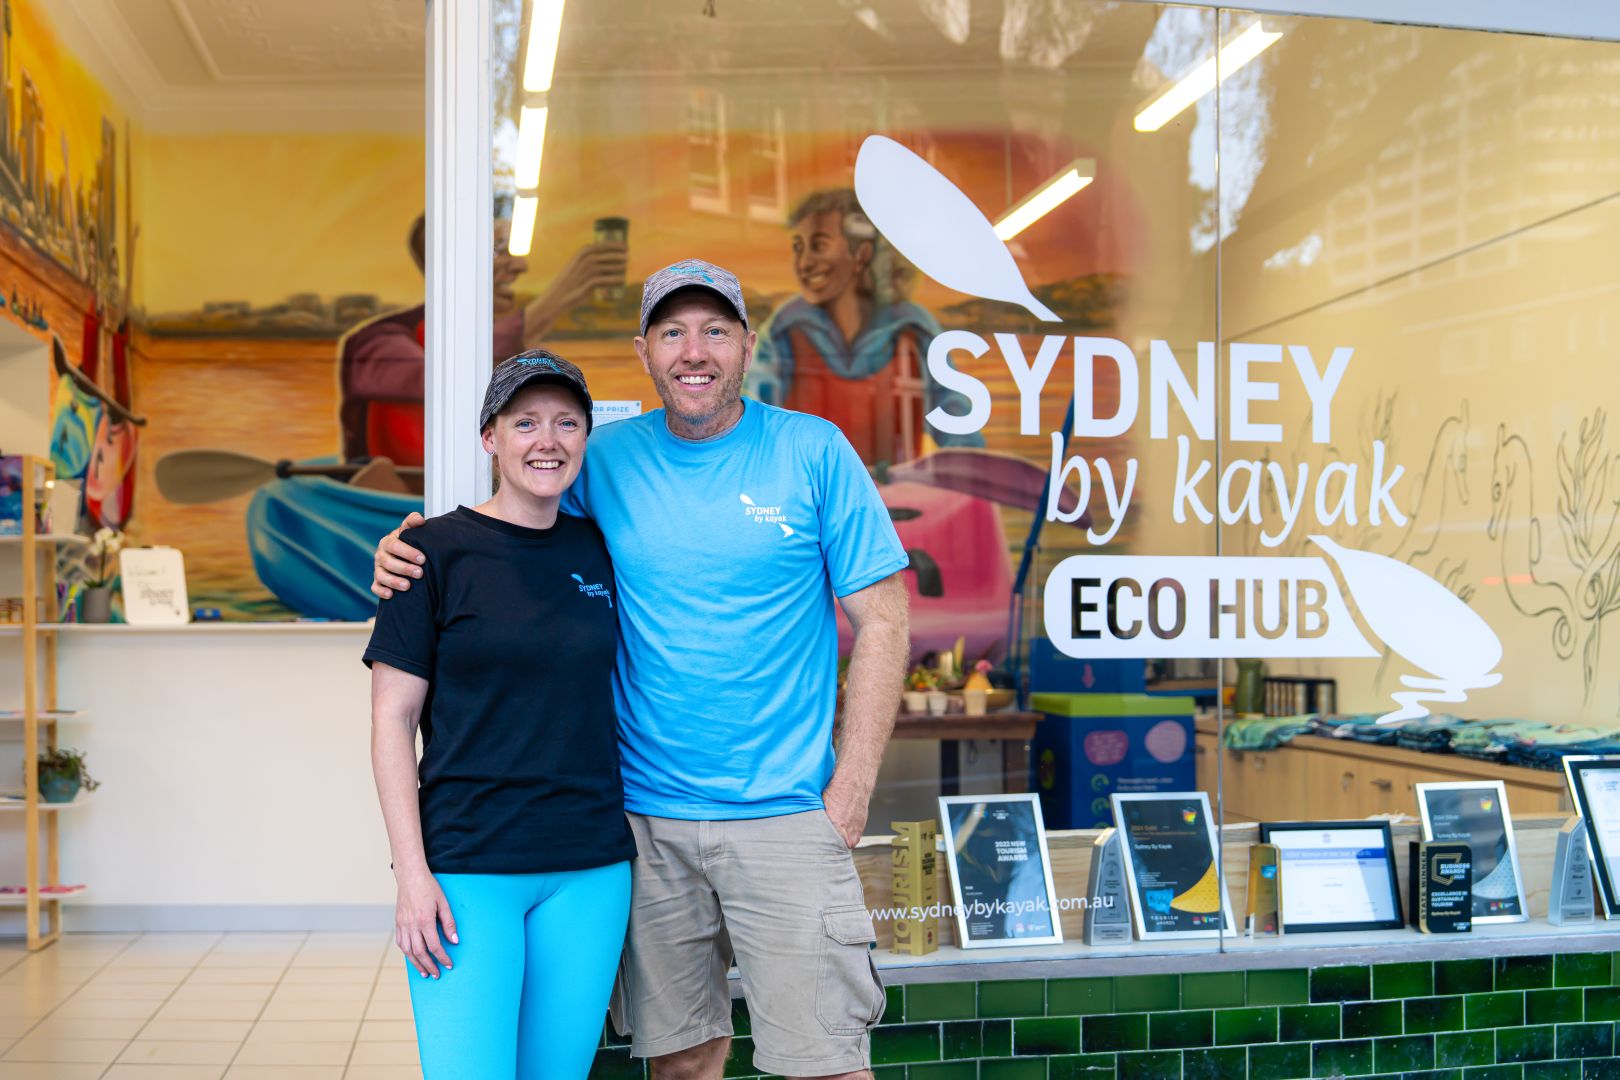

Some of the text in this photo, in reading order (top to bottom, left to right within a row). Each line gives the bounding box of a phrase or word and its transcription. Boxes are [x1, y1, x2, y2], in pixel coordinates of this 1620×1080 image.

[925, 330, 1355, 443] SYDNEY
[1046, 432, 1407, 548] by kayak
[745, 506, 781, 515] SYDNEY
[754, 514, 787, 524] by kayak
[578, 583, 603, 592] SYDNEY
[1070, 577, 1330, 639] ECO HUB
[995, 847, 1028, 855] TOURISM
[997, 854, 1029, 862] AWARDS
[890, 821, 911, 955] TOURISM
